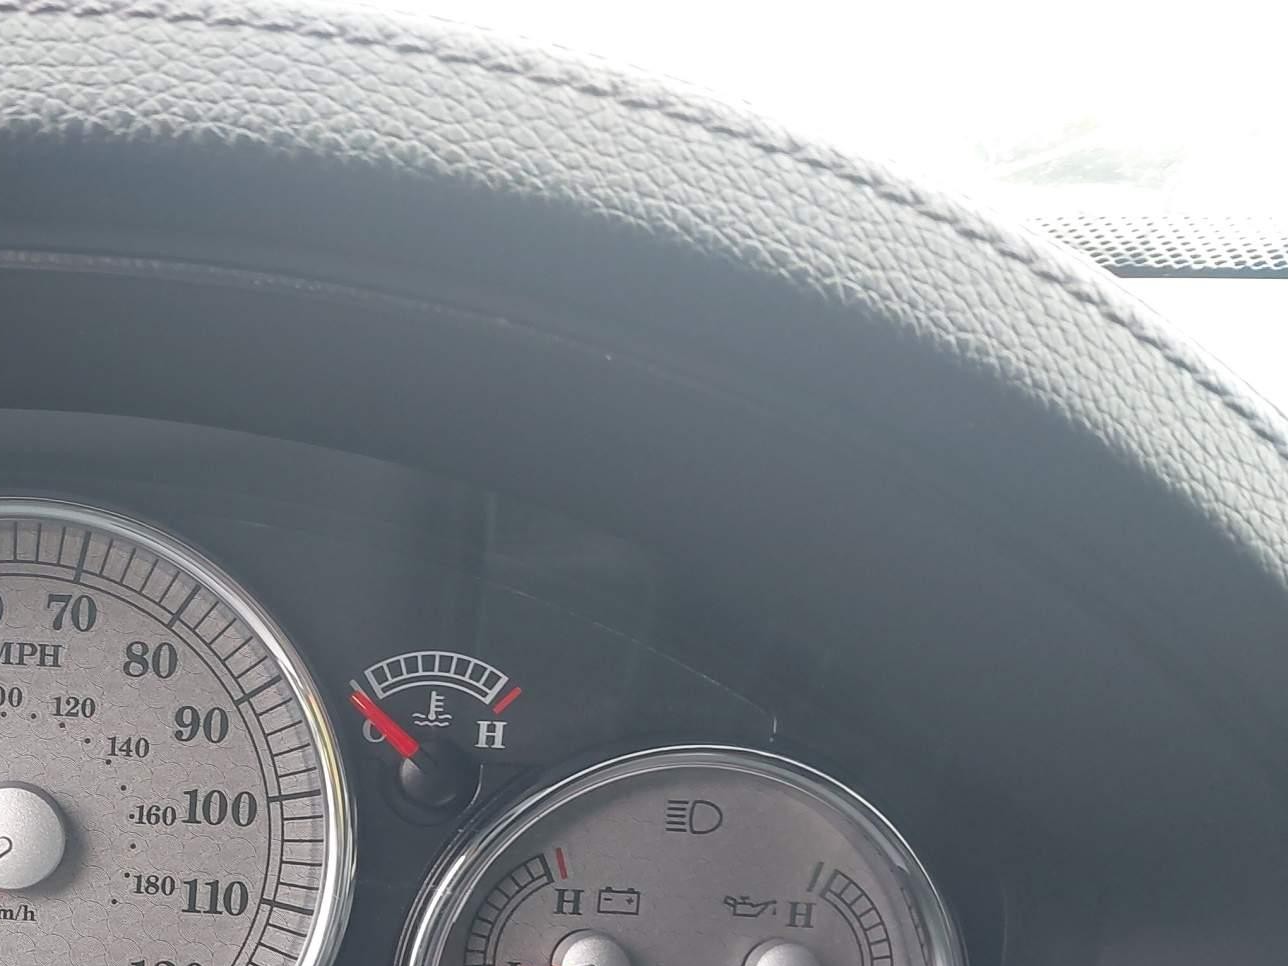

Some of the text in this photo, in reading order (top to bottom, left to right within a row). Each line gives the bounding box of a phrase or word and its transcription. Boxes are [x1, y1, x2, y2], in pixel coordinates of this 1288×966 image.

[47, 594, 97, 632] 70
[123, 641, 178, 679] 80
[52, 697, 95, 718] 120
[175, 706, 228, 743] 90
[476, 721, 507, 748] H
[108, 737, 149, 758] 140
[135, 805, 176, 826] 160
[182, 789, 257, 827] 100
[134, 875, 175, 896] 180
[182, 879, 248, 916] 110
[554, 889, 584, 915] H
[786, 902, 816, 928] H
